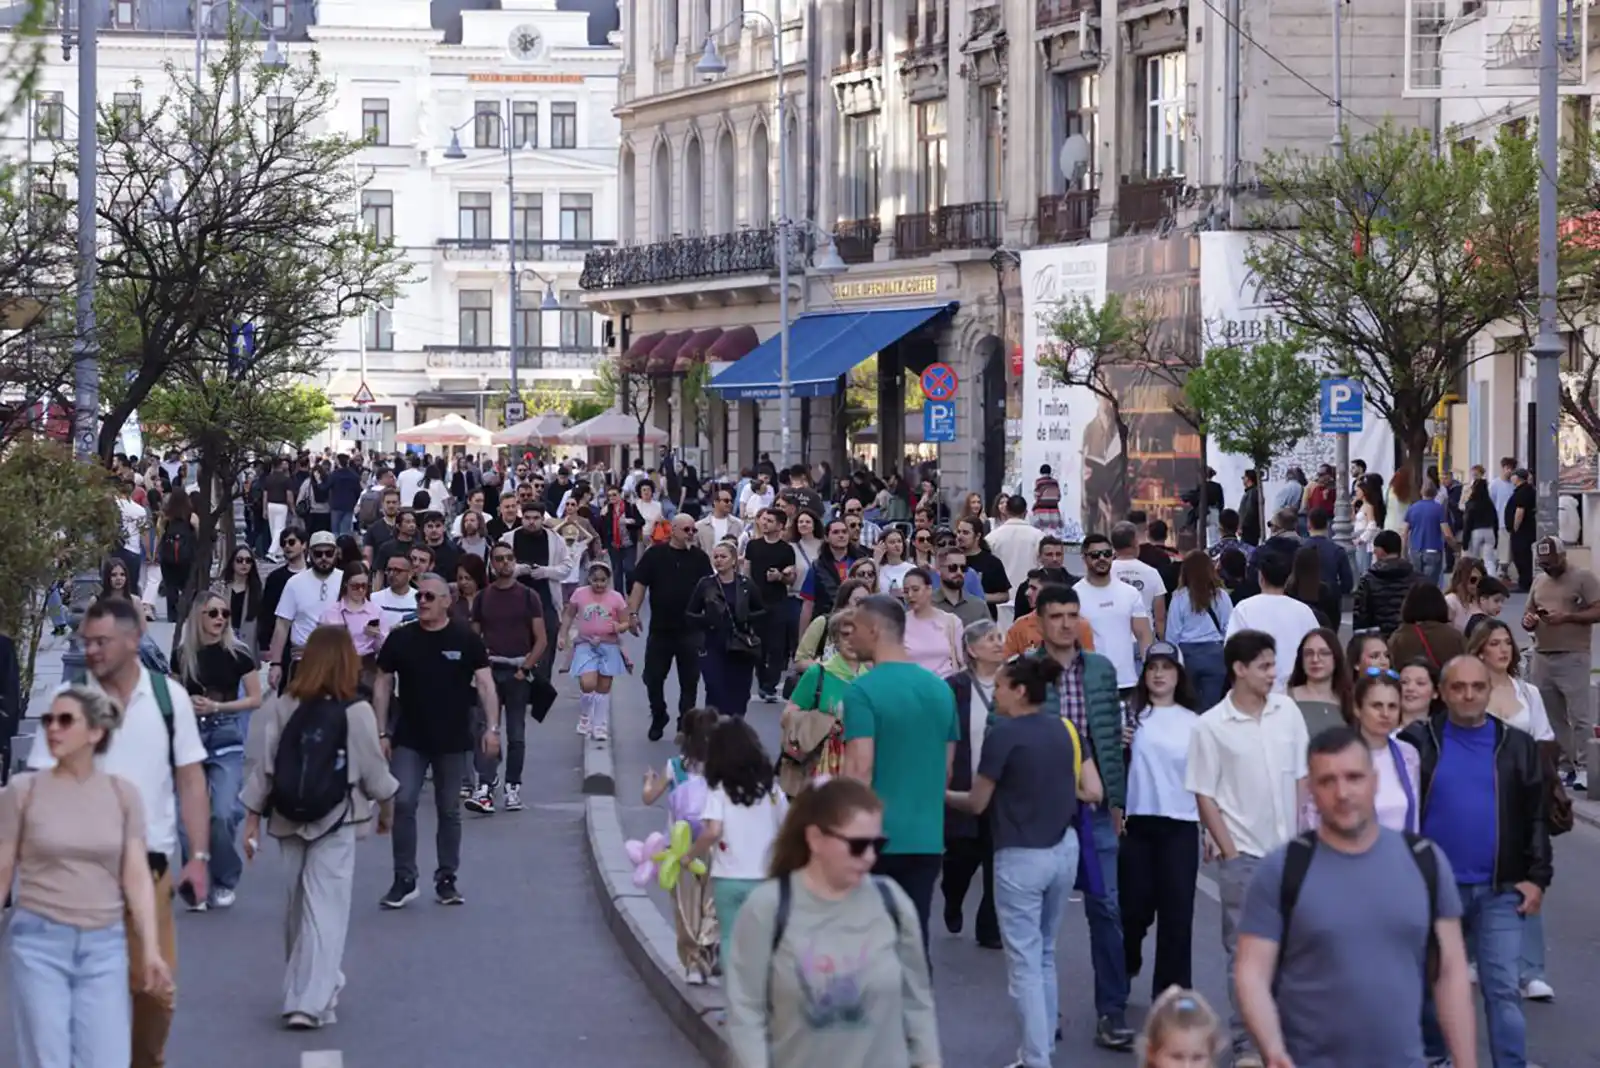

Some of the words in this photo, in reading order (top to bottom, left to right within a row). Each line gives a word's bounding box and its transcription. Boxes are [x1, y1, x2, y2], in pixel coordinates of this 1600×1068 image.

[1045, 398, 1069, 416] milion
[1330, 384, 1352, 415] P
[932, 406, 947, 428] P
[1037, 421, 1047, 441] de
[1049, 421, 1071, 441] titluri
